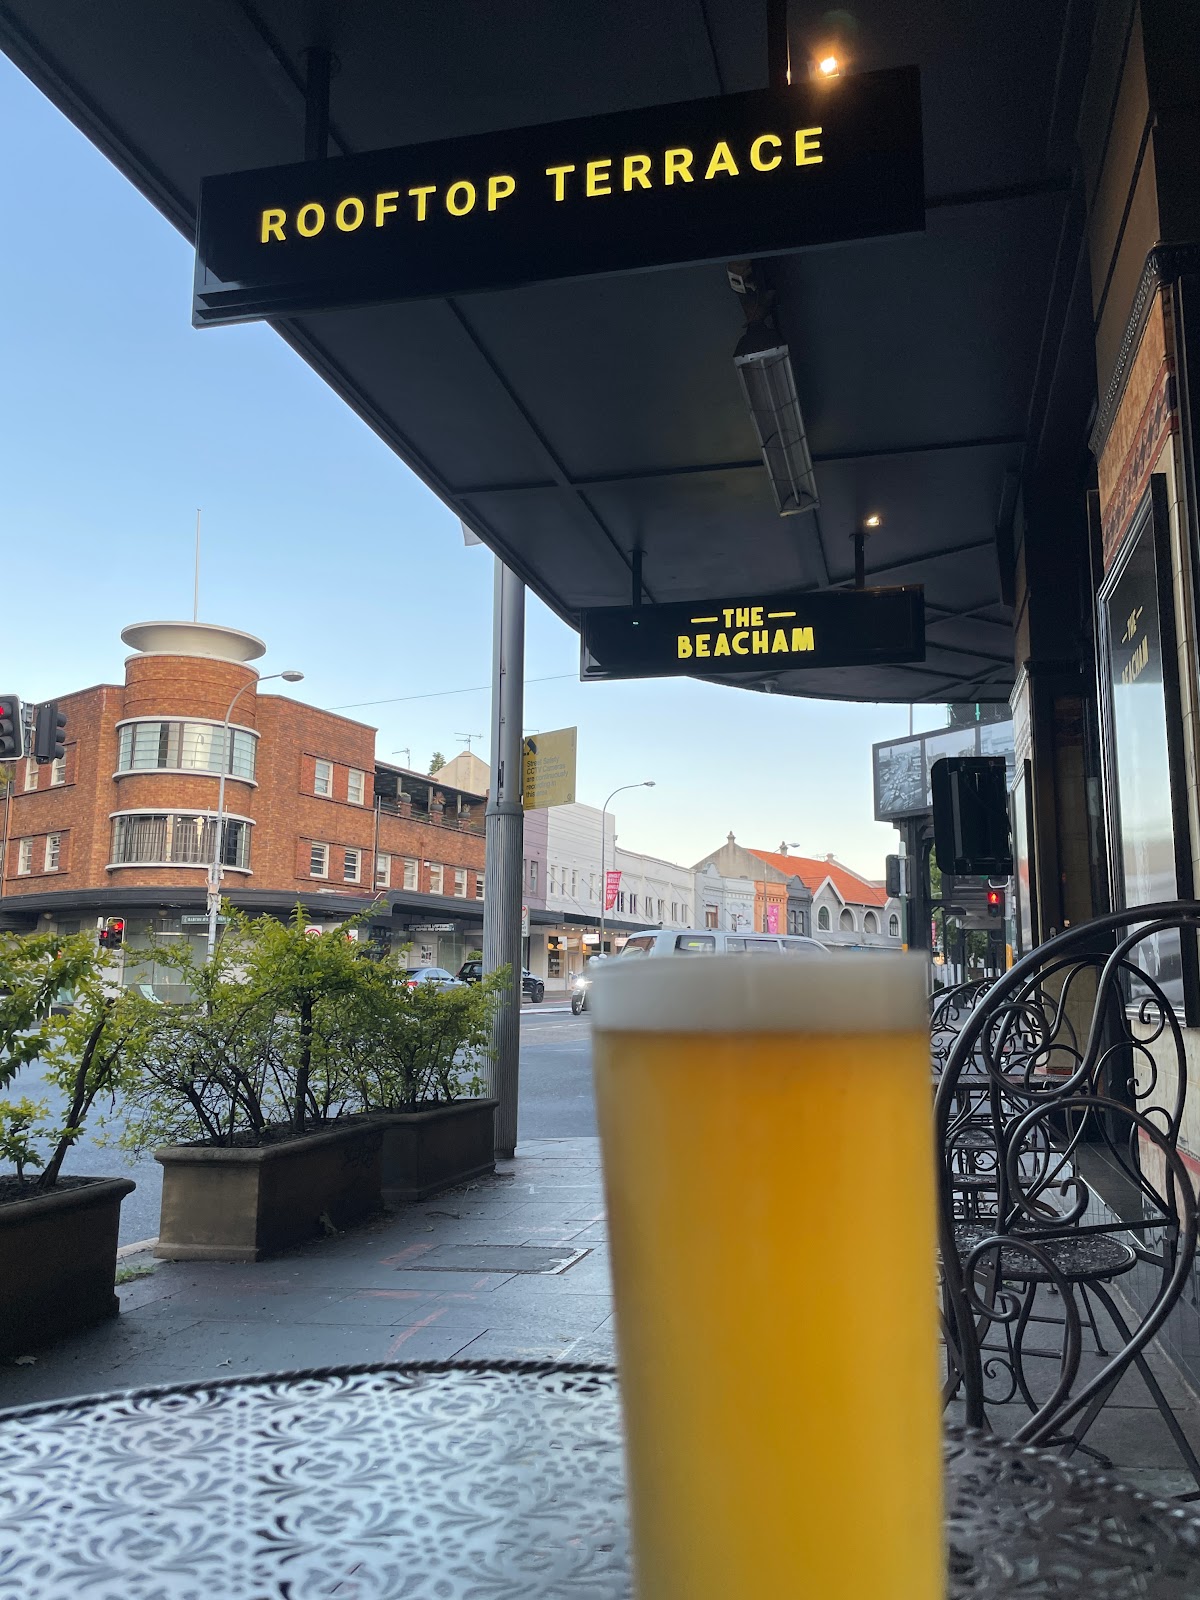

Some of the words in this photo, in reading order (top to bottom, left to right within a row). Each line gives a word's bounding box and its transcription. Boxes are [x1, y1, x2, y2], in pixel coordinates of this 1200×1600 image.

[261, 175, 516, 244] ROOFTOP
[545, 126, 824, 202] TERRACE
[722, 606, 765, 628] THE
[677, 626, 815, 659] BEACHAM
[527, 759, 542, 768] Street
[527, 766, 542, 775] CCTV
[526, 790, 535, 798] this
